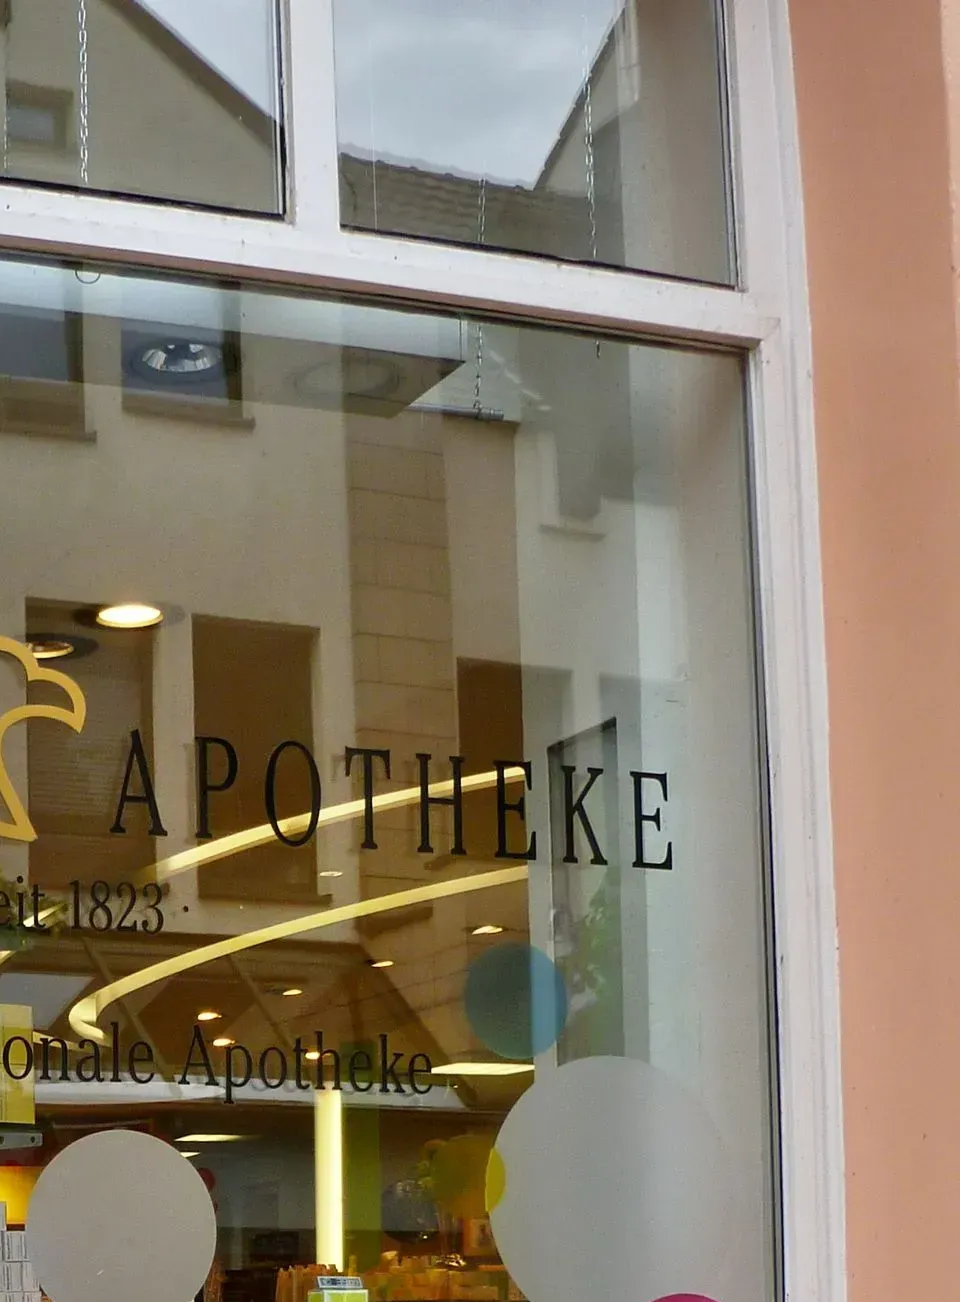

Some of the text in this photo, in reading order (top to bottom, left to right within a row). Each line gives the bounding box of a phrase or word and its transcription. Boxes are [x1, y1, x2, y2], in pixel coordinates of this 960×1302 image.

[110, 729, 673, 871] APOTHEKE
[69, 879, 165, 935] 1823
[178, 1024, 435, 1101] Apotheke
